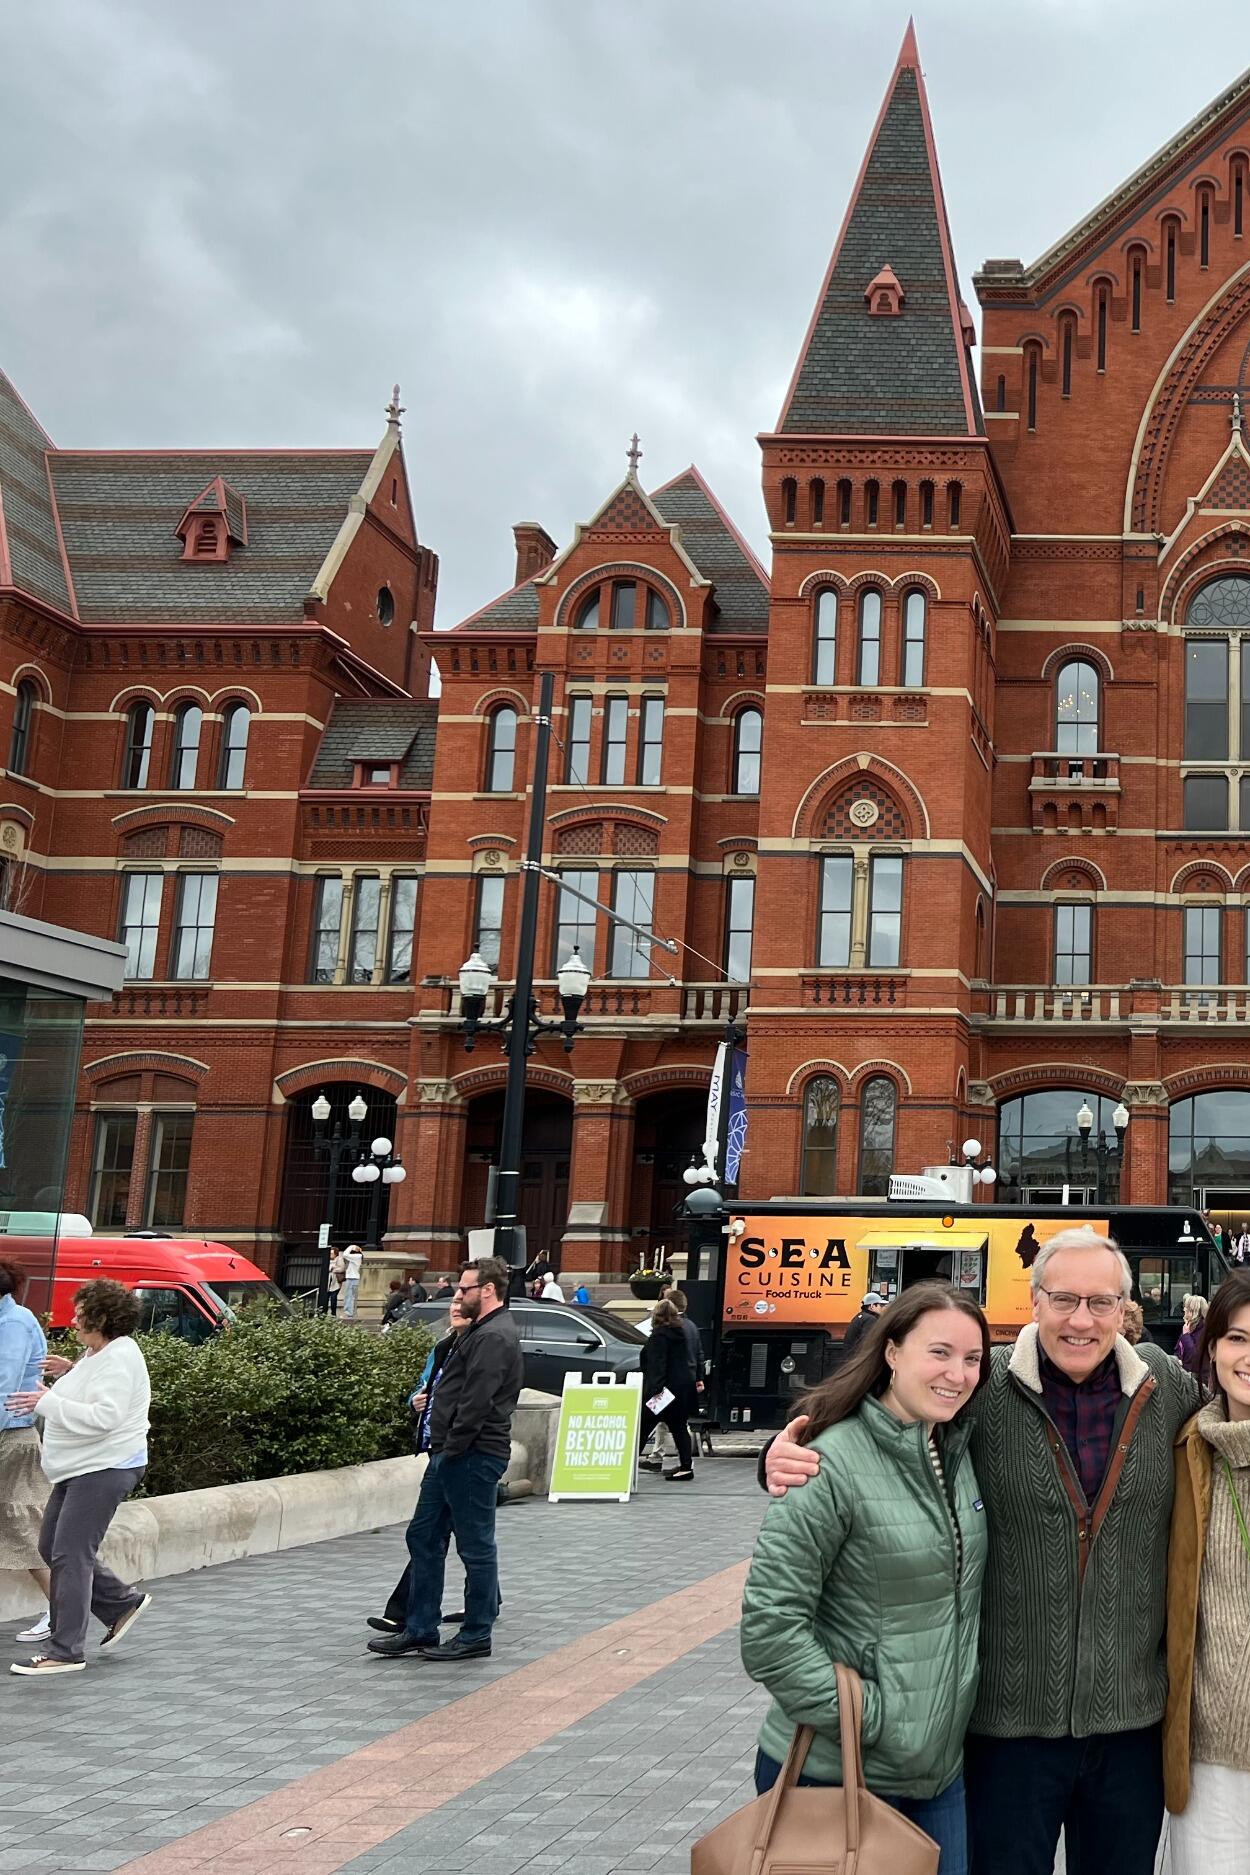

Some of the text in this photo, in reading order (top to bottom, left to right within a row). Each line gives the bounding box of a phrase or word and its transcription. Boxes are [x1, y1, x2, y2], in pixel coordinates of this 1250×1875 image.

[710, 1075, 720, 1112] MAY
[738, 1272, 851, 1287] CUISINE
[765, 1290, 822, 1299] Food Truck
[569, 1415, 628, 1429] NO ALCOHOL
[566, 1431, 626, 1450] BEYOND
[565, 1451, 624, 1467] THIS POINT
